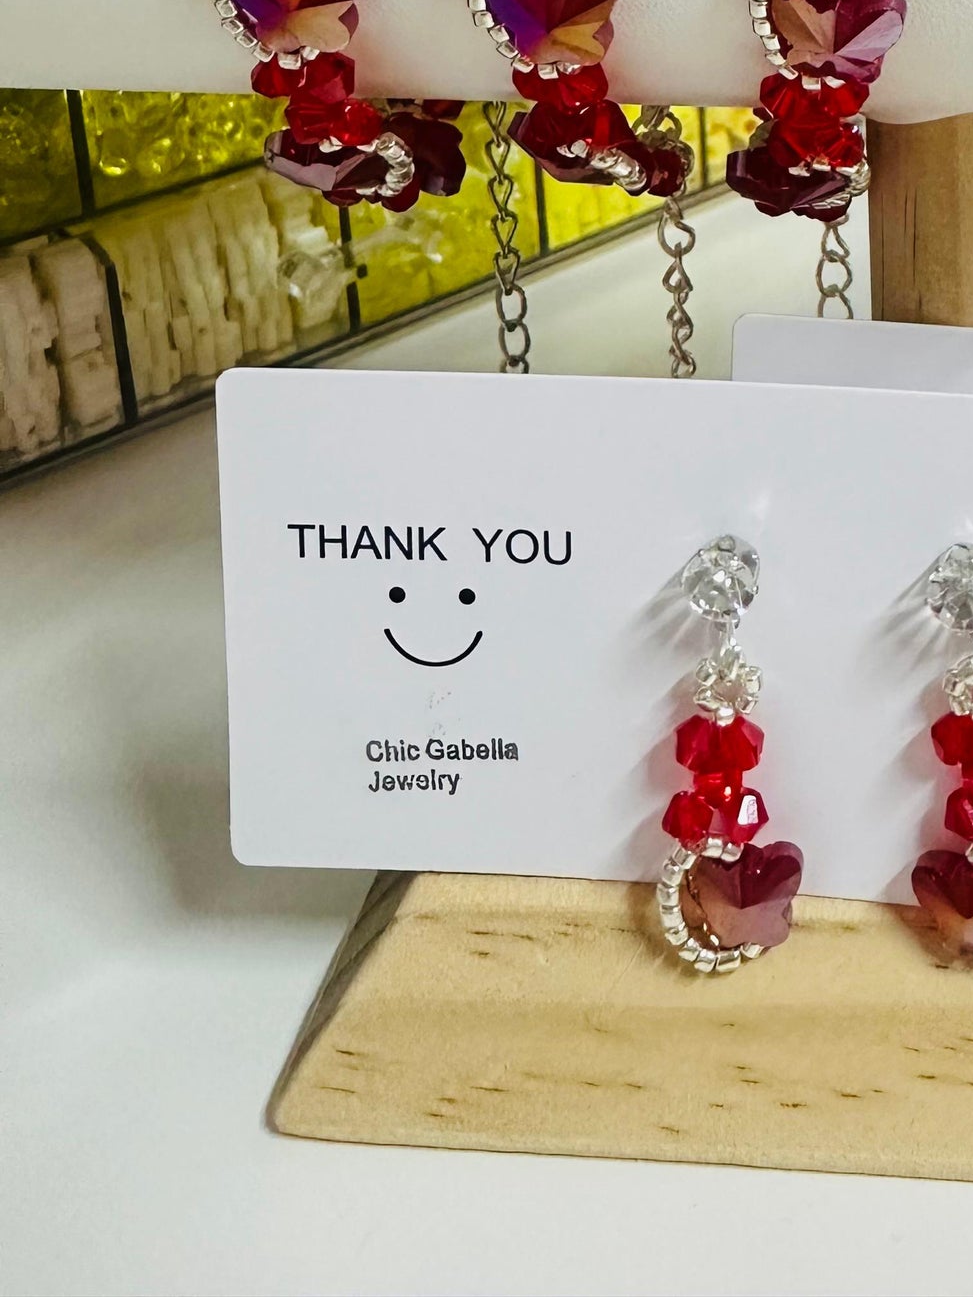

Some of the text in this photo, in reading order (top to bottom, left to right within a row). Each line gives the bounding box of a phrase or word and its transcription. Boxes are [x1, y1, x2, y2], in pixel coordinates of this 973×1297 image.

[287, 523, 572, 566] THANK YOU
[366, 738, 519, 763] Chic Gabella
[368, 769, 460, 796] Jewelry
